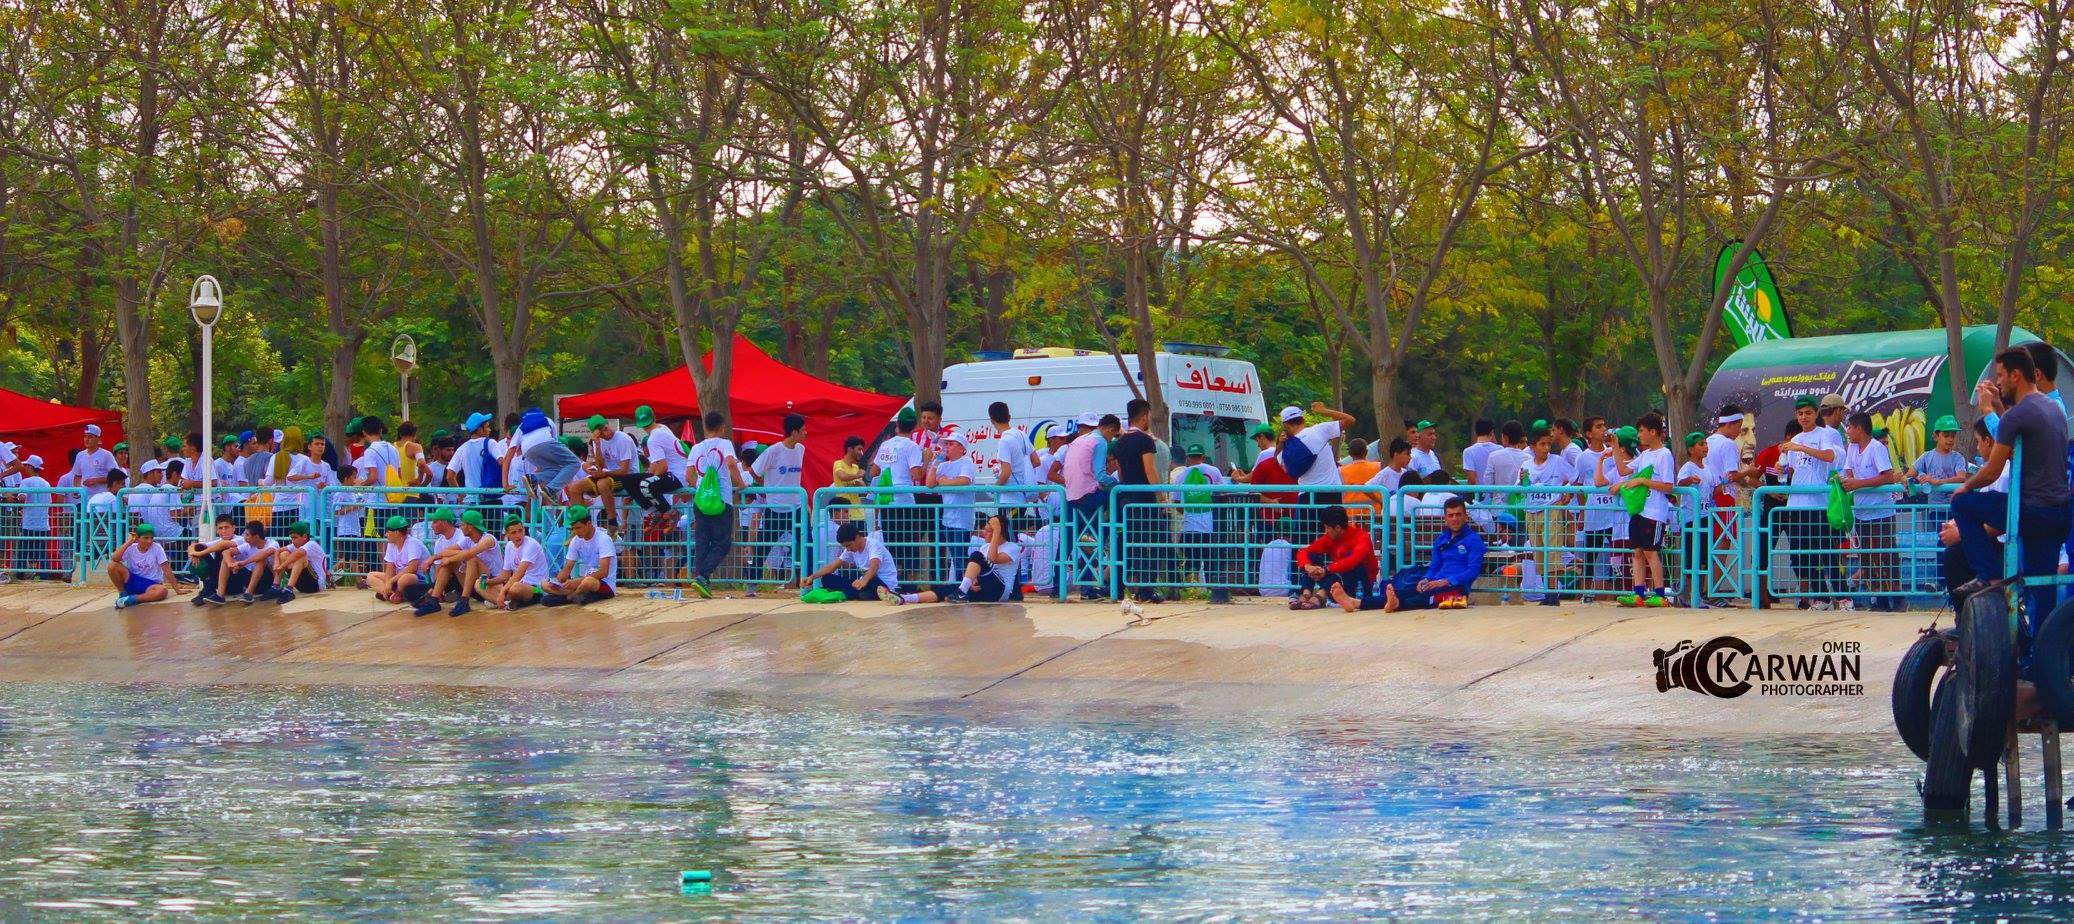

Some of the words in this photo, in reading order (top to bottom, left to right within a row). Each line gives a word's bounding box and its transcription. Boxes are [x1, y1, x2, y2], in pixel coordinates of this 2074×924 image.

[1175, 363, 1252, 395] اسعاف
[1530, 493, 1552, 501] 1441
[1596, 496, 1614, 504] 161
